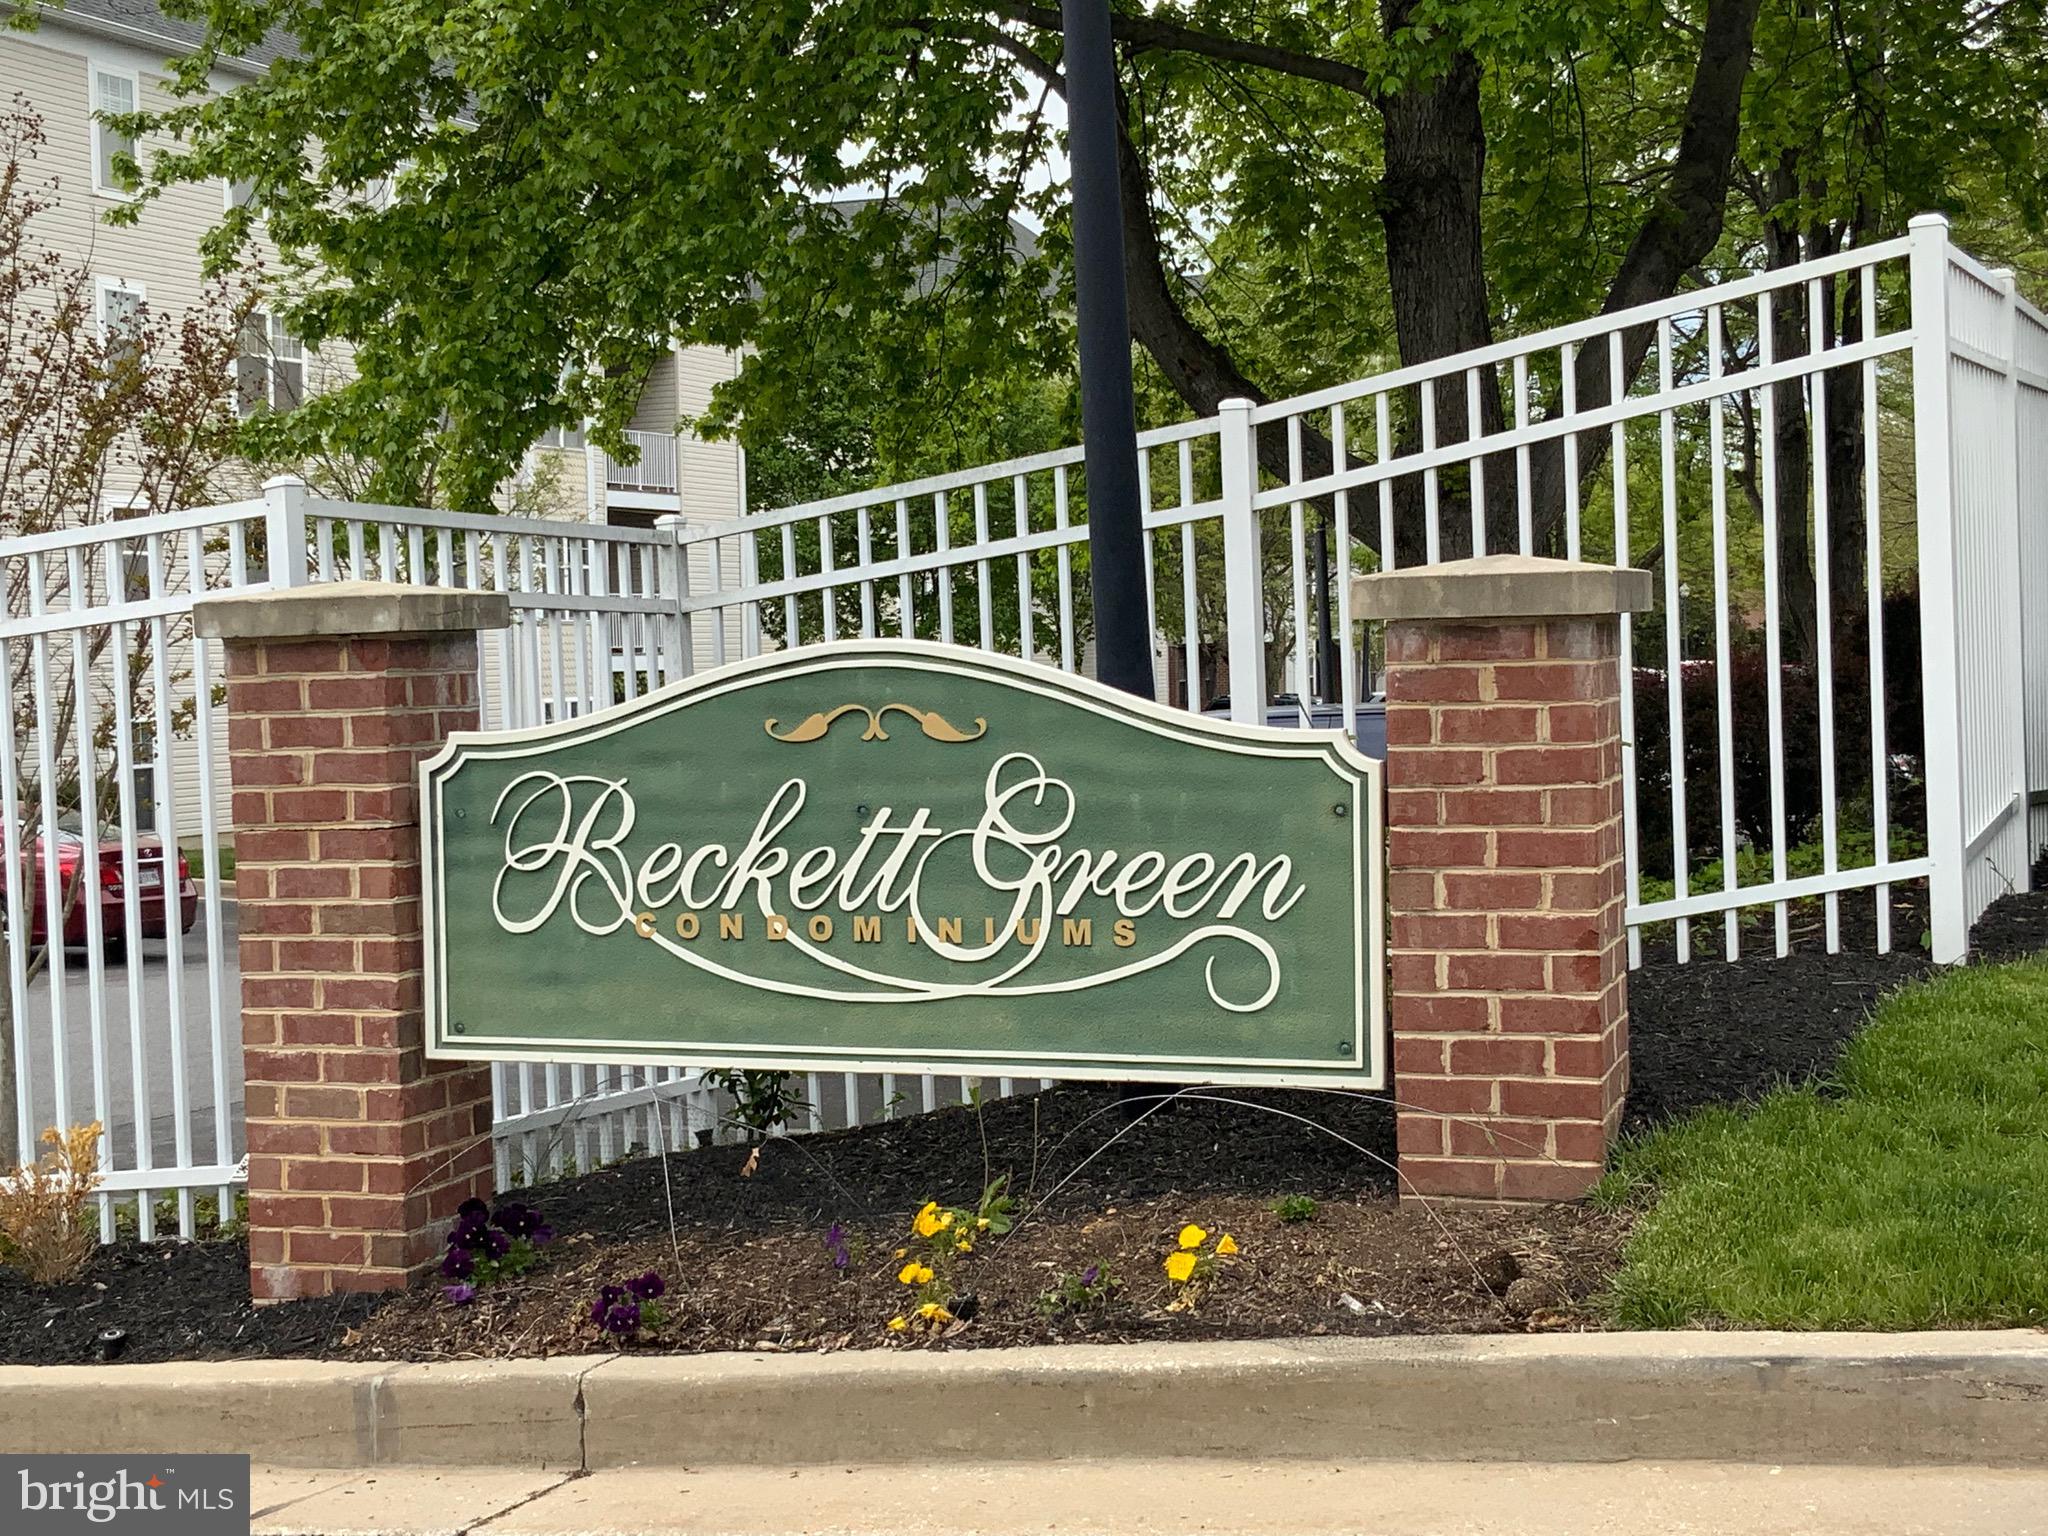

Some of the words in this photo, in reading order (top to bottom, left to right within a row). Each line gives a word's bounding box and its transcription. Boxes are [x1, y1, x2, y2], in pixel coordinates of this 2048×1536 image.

[490, 770, 942, 936] Beckett
[910, 752, 1307, 963] Green
[634, 912, 1138, 946] CONDOMINIUMS
